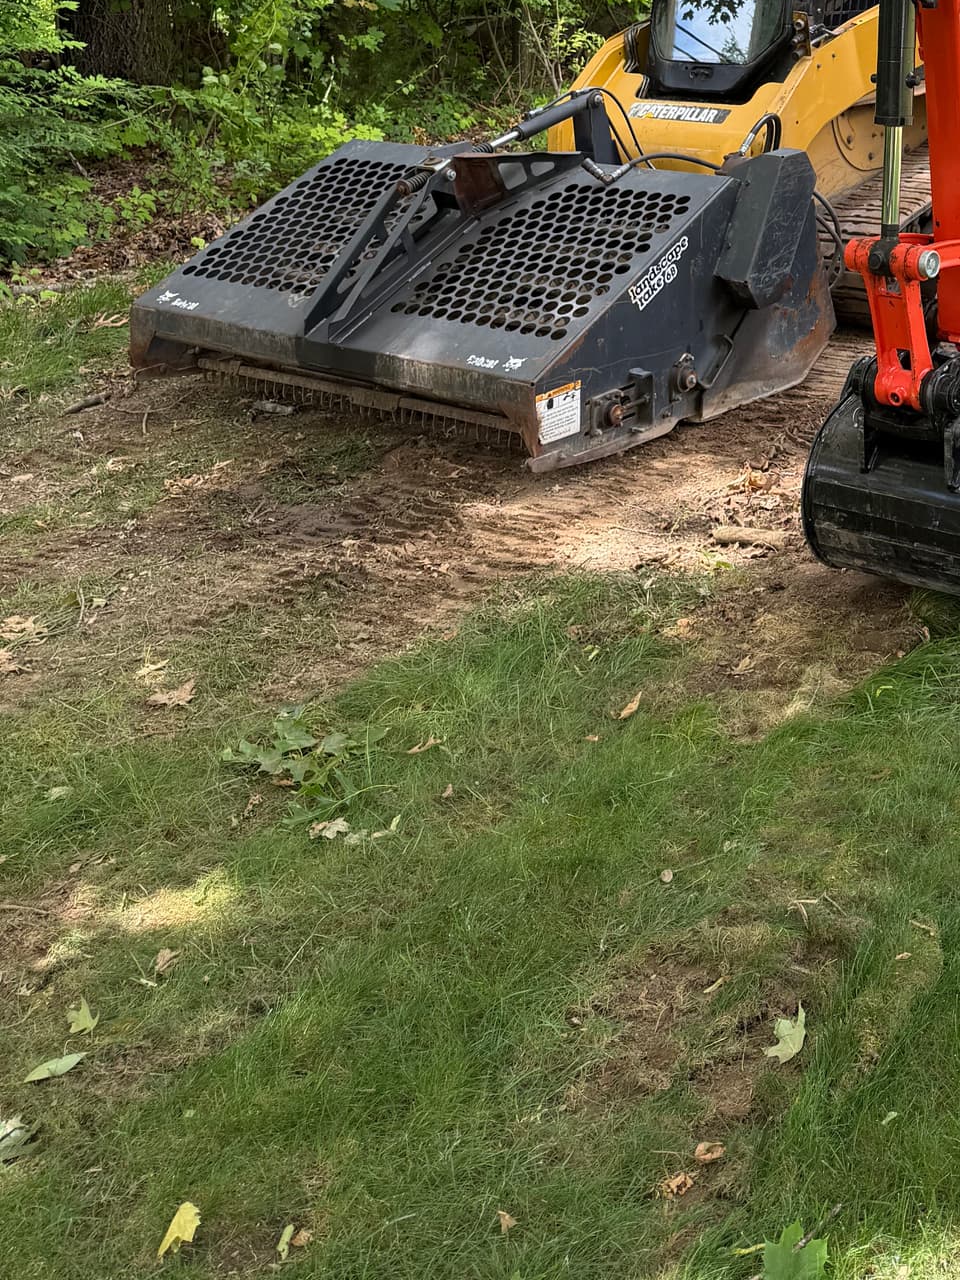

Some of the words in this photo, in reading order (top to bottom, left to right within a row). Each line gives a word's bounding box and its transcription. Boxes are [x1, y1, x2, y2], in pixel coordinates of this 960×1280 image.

[638, 104, 718, 123] CATERPILLAR
[628, 236, 688, 304] landscape
[638, 274, 664, 311] rake
[665, 264, 678, 284] 6B
